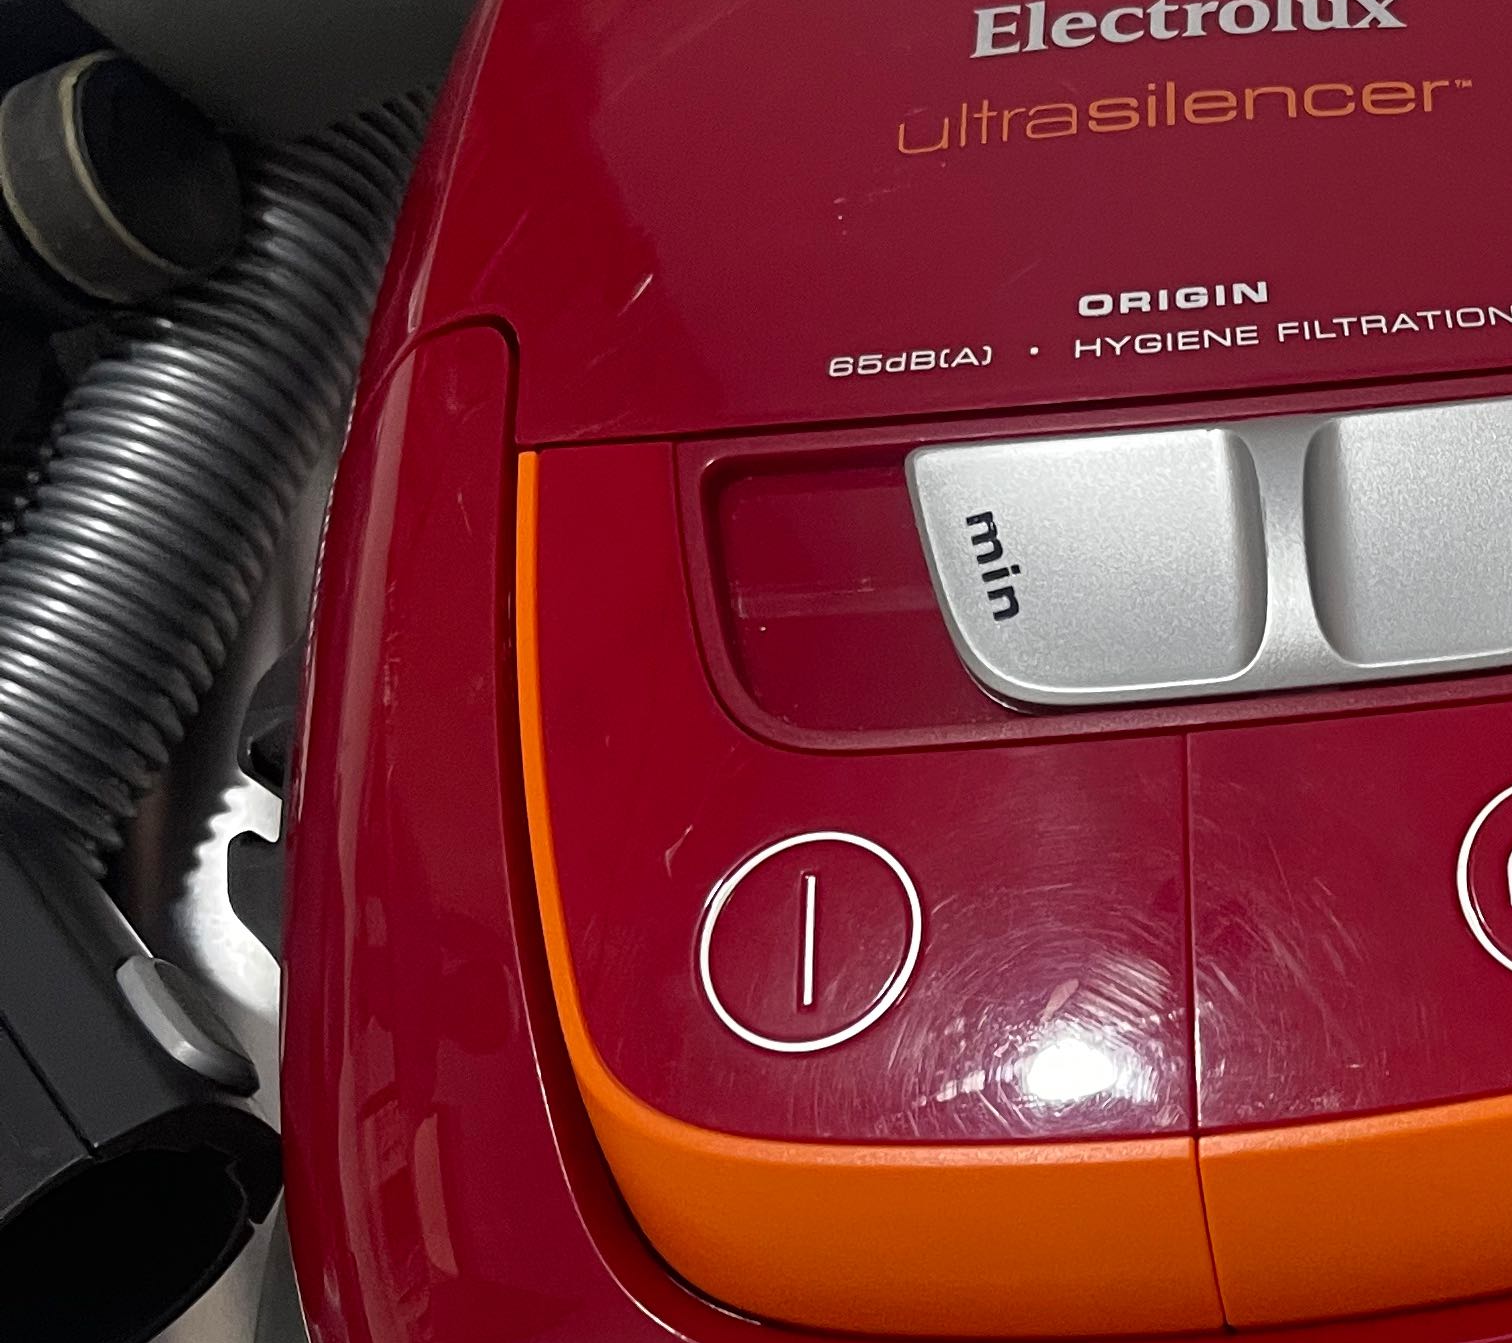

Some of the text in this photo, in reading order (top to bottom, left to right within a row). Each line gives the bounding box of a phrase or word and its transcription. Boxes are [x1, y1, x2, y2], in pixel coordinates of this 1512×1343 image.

[1077, 280, 1269, 318] ORIGIN
[828, 345, 993, 378] 65dB(A)
[1074, 325, 1260, 359] HYGIENE
[965, 510, 1022, 623] min
